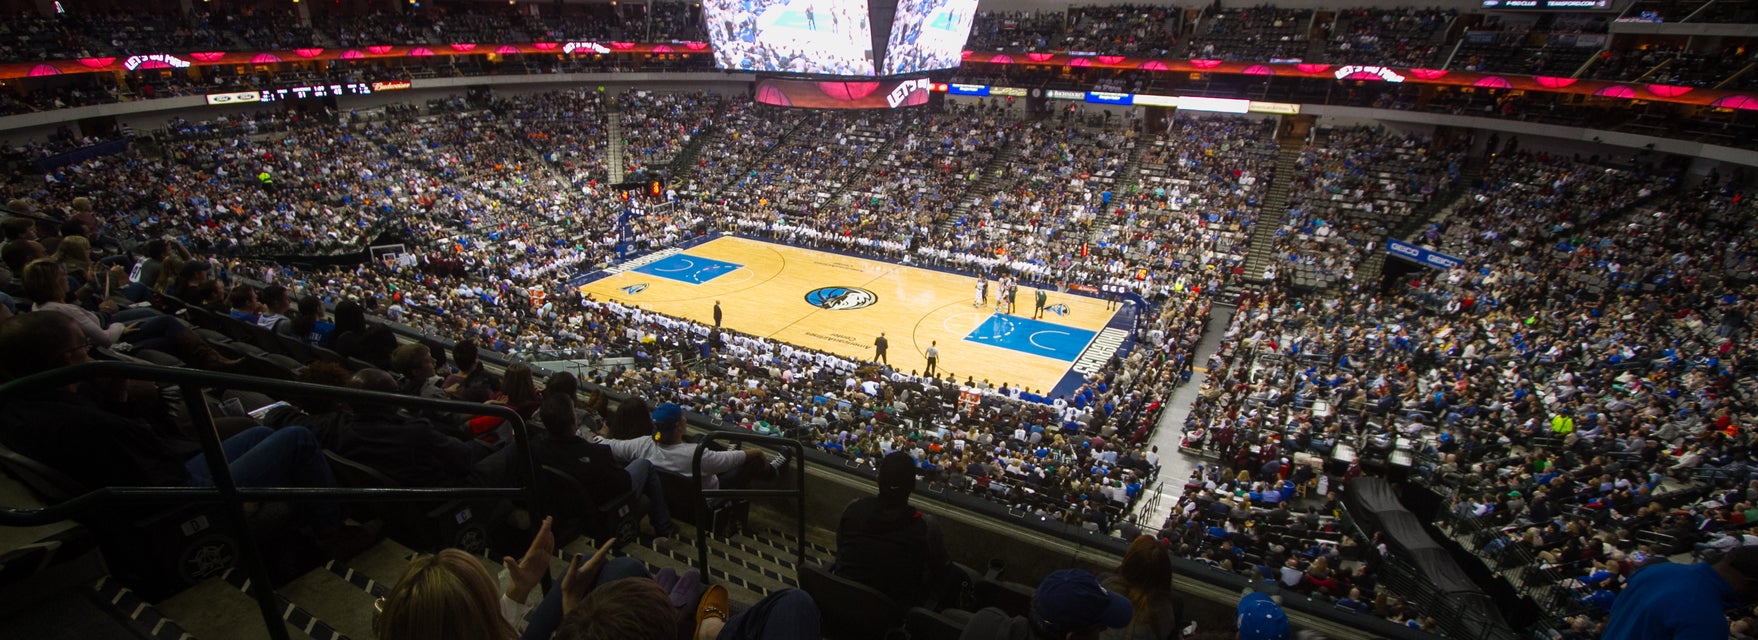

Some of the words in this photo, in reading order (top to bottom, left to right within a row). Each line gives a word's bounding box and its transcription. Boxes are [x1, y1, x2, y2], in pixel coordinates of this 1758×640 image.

[372, 81, 410, 92] Budweiser
[886, 79, 917, 108] LET'S
[1391, 243, 1419, 256] GEICO
[1428, 254, 1458, 268] GEICO
